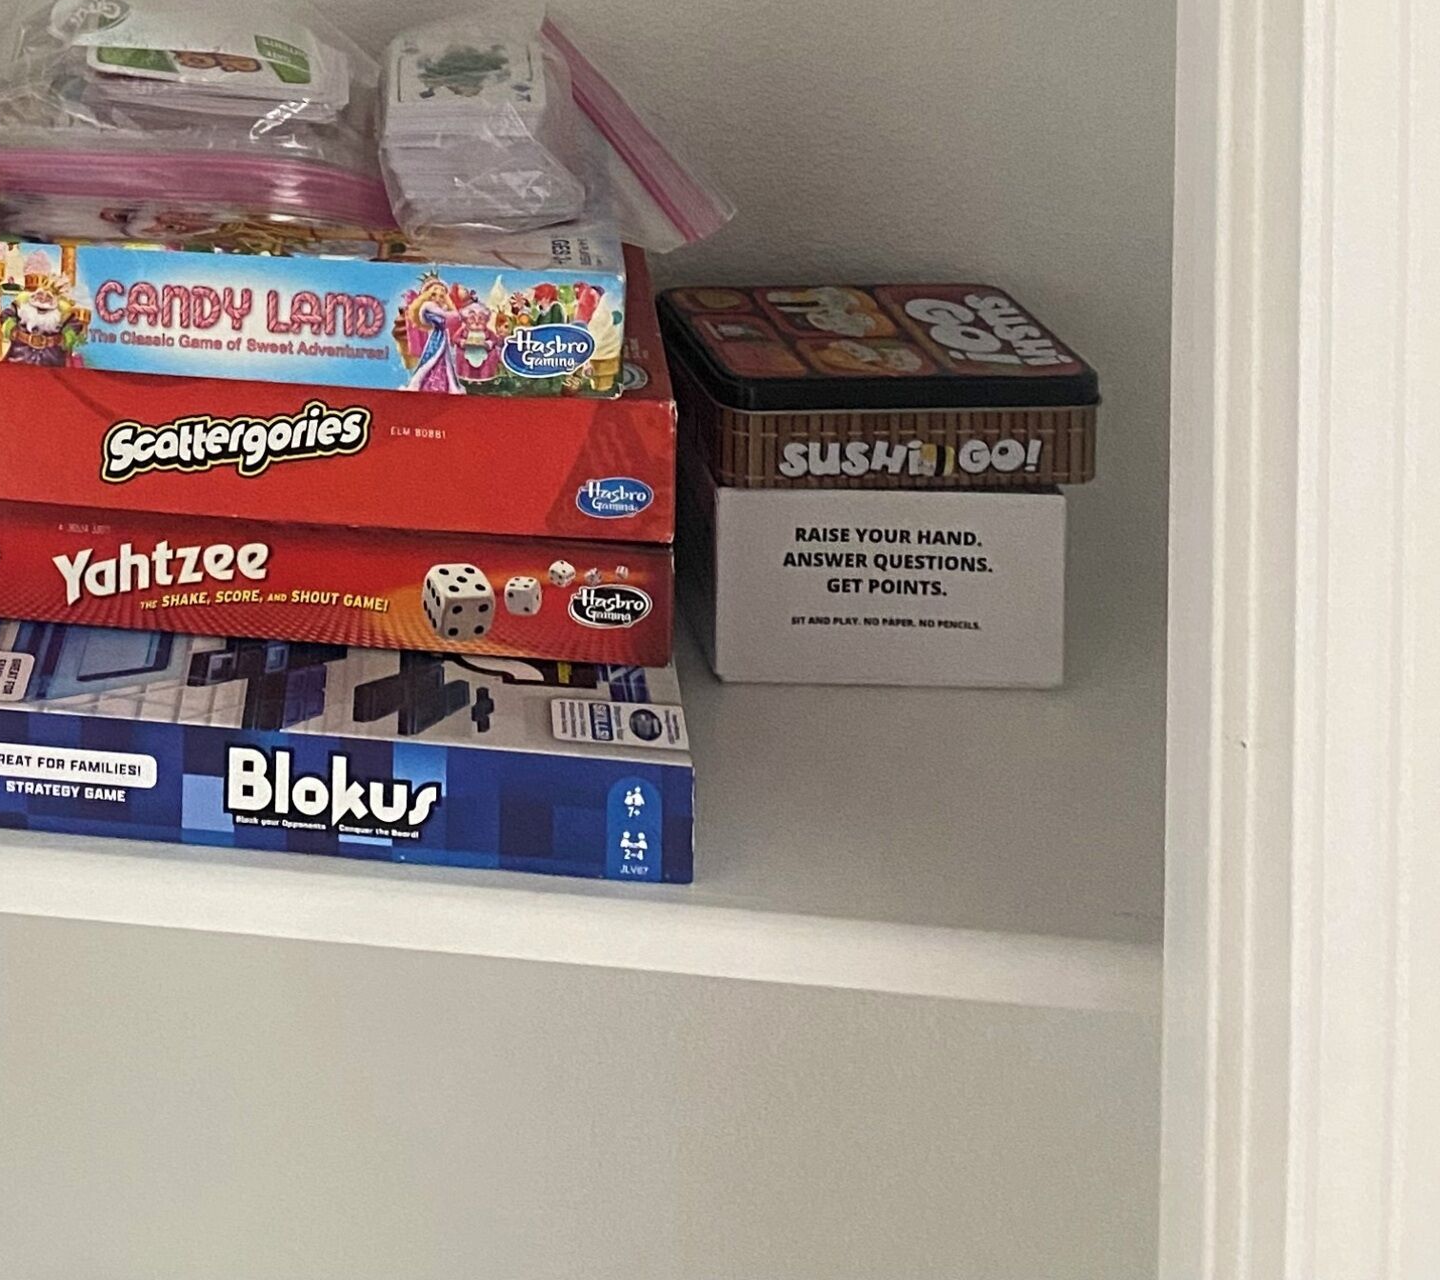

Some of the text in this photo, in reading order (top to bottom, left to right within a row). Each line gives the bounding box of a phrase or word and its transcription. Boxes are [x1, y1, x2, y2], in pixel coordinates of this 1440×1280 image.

[95, 280, 387, 338] CANDY LAND
[89, 329, 389, 360] The Classic Game of Sweet Adventures!
[517, 330, 588, 357] Hasbro
[523, 351, 576, 371] Gaming
[108, 406, 363, 473] Scattergories
[959, 439, 1042, 473] GO!
[795, 527, 982, 546] RAISE YOUR HAND.
[52, 541, 269, 606] Yahtzee
[783, 552, 993, 573] ANSWER QUESTIONS.
[827, 578, 947, 596] GET POINTS.
[141, 590, 390, 612] THE SHAKE, SCORE, AND SHOUT GAME!
[574, 587, 648, 611] Hasbro
[584, 607, 632, 623] Gaming
[792, 616, 980, 630] SIT AND PLAY. NO PAPER. NO PENCILS.
[38, 757, 65, 770] FOR
[71, 759, 141, 777] FAMILIES!
[6, 780, 126, 802] STRATEGY GAME
[227, 747, 437, 826] Blokus
